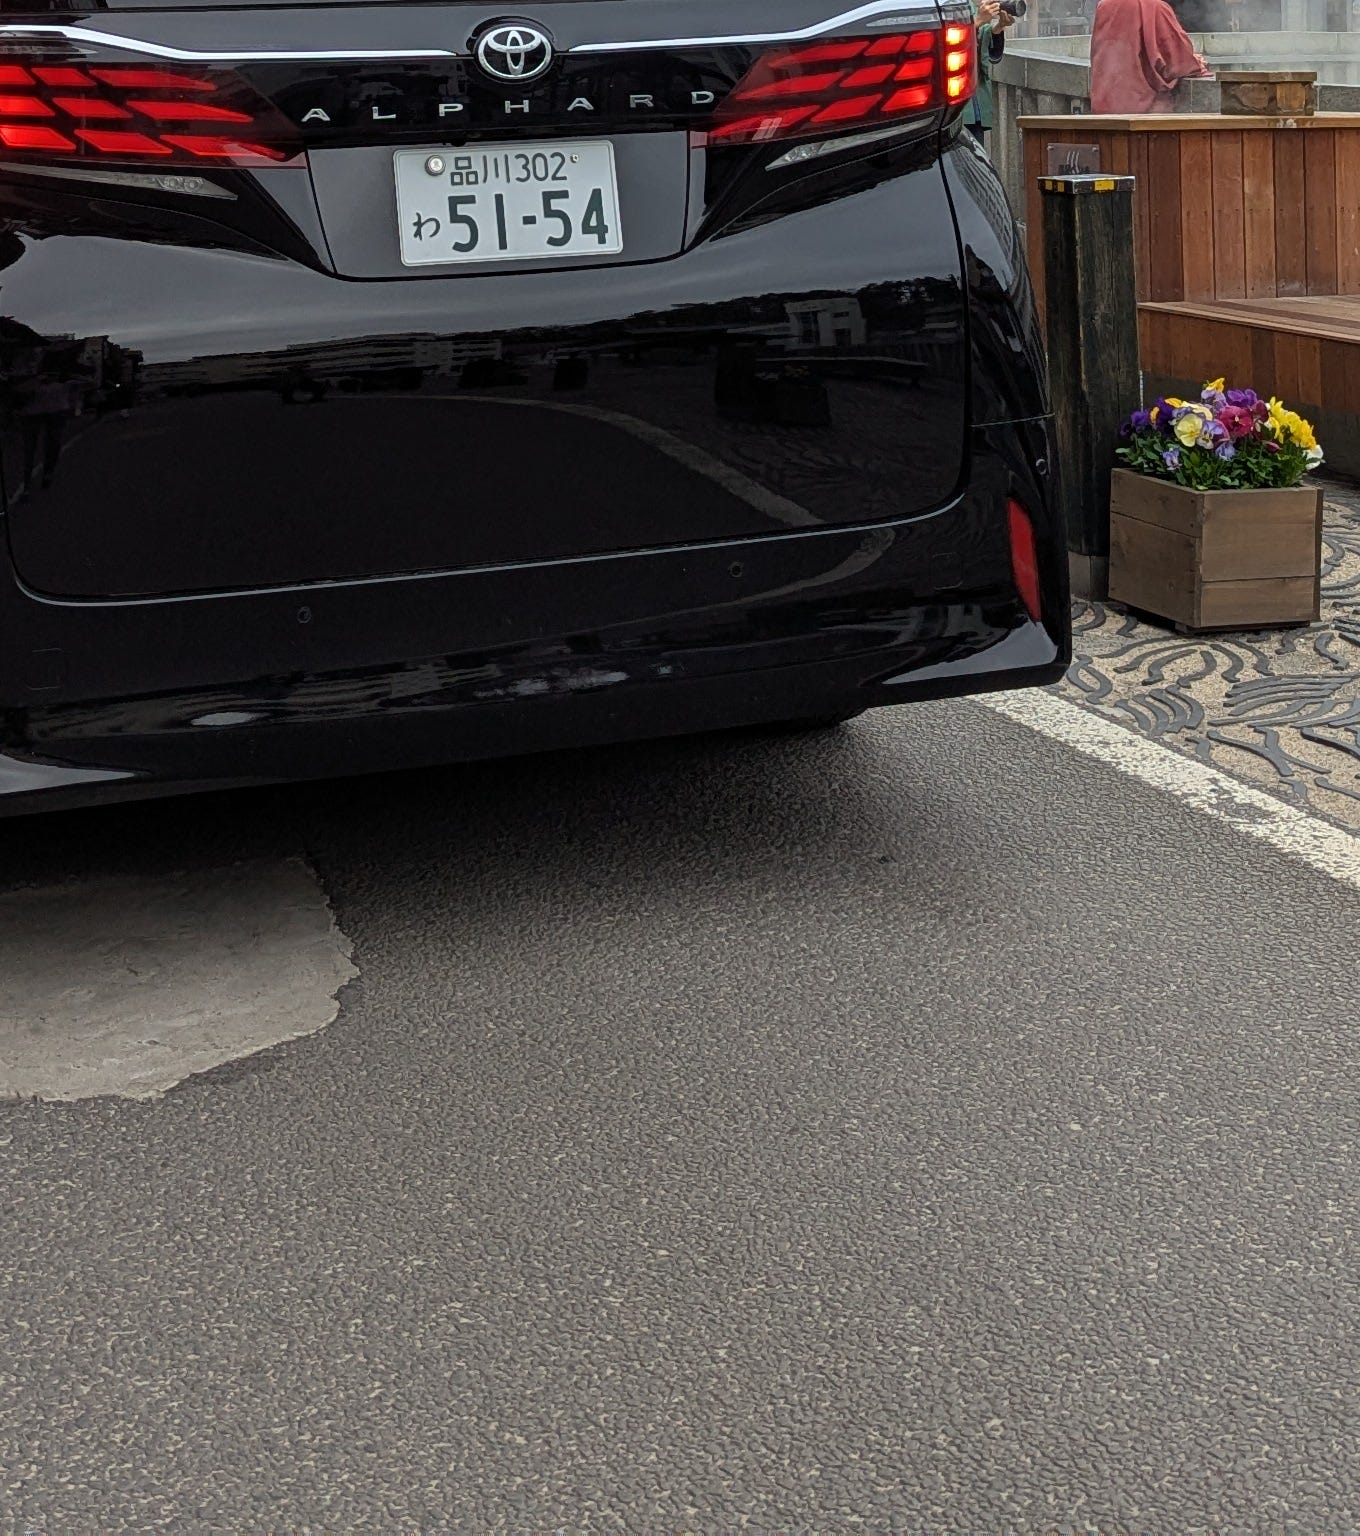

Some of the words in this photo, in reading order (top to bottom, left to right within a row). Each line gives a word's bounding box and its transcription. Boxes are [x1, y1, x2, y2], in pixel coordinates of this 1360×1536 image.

[301, 90, 715, 122] ALPHARD
[412, 210, 441, 242] わ
[448, 188, 610, 254] 51-54
